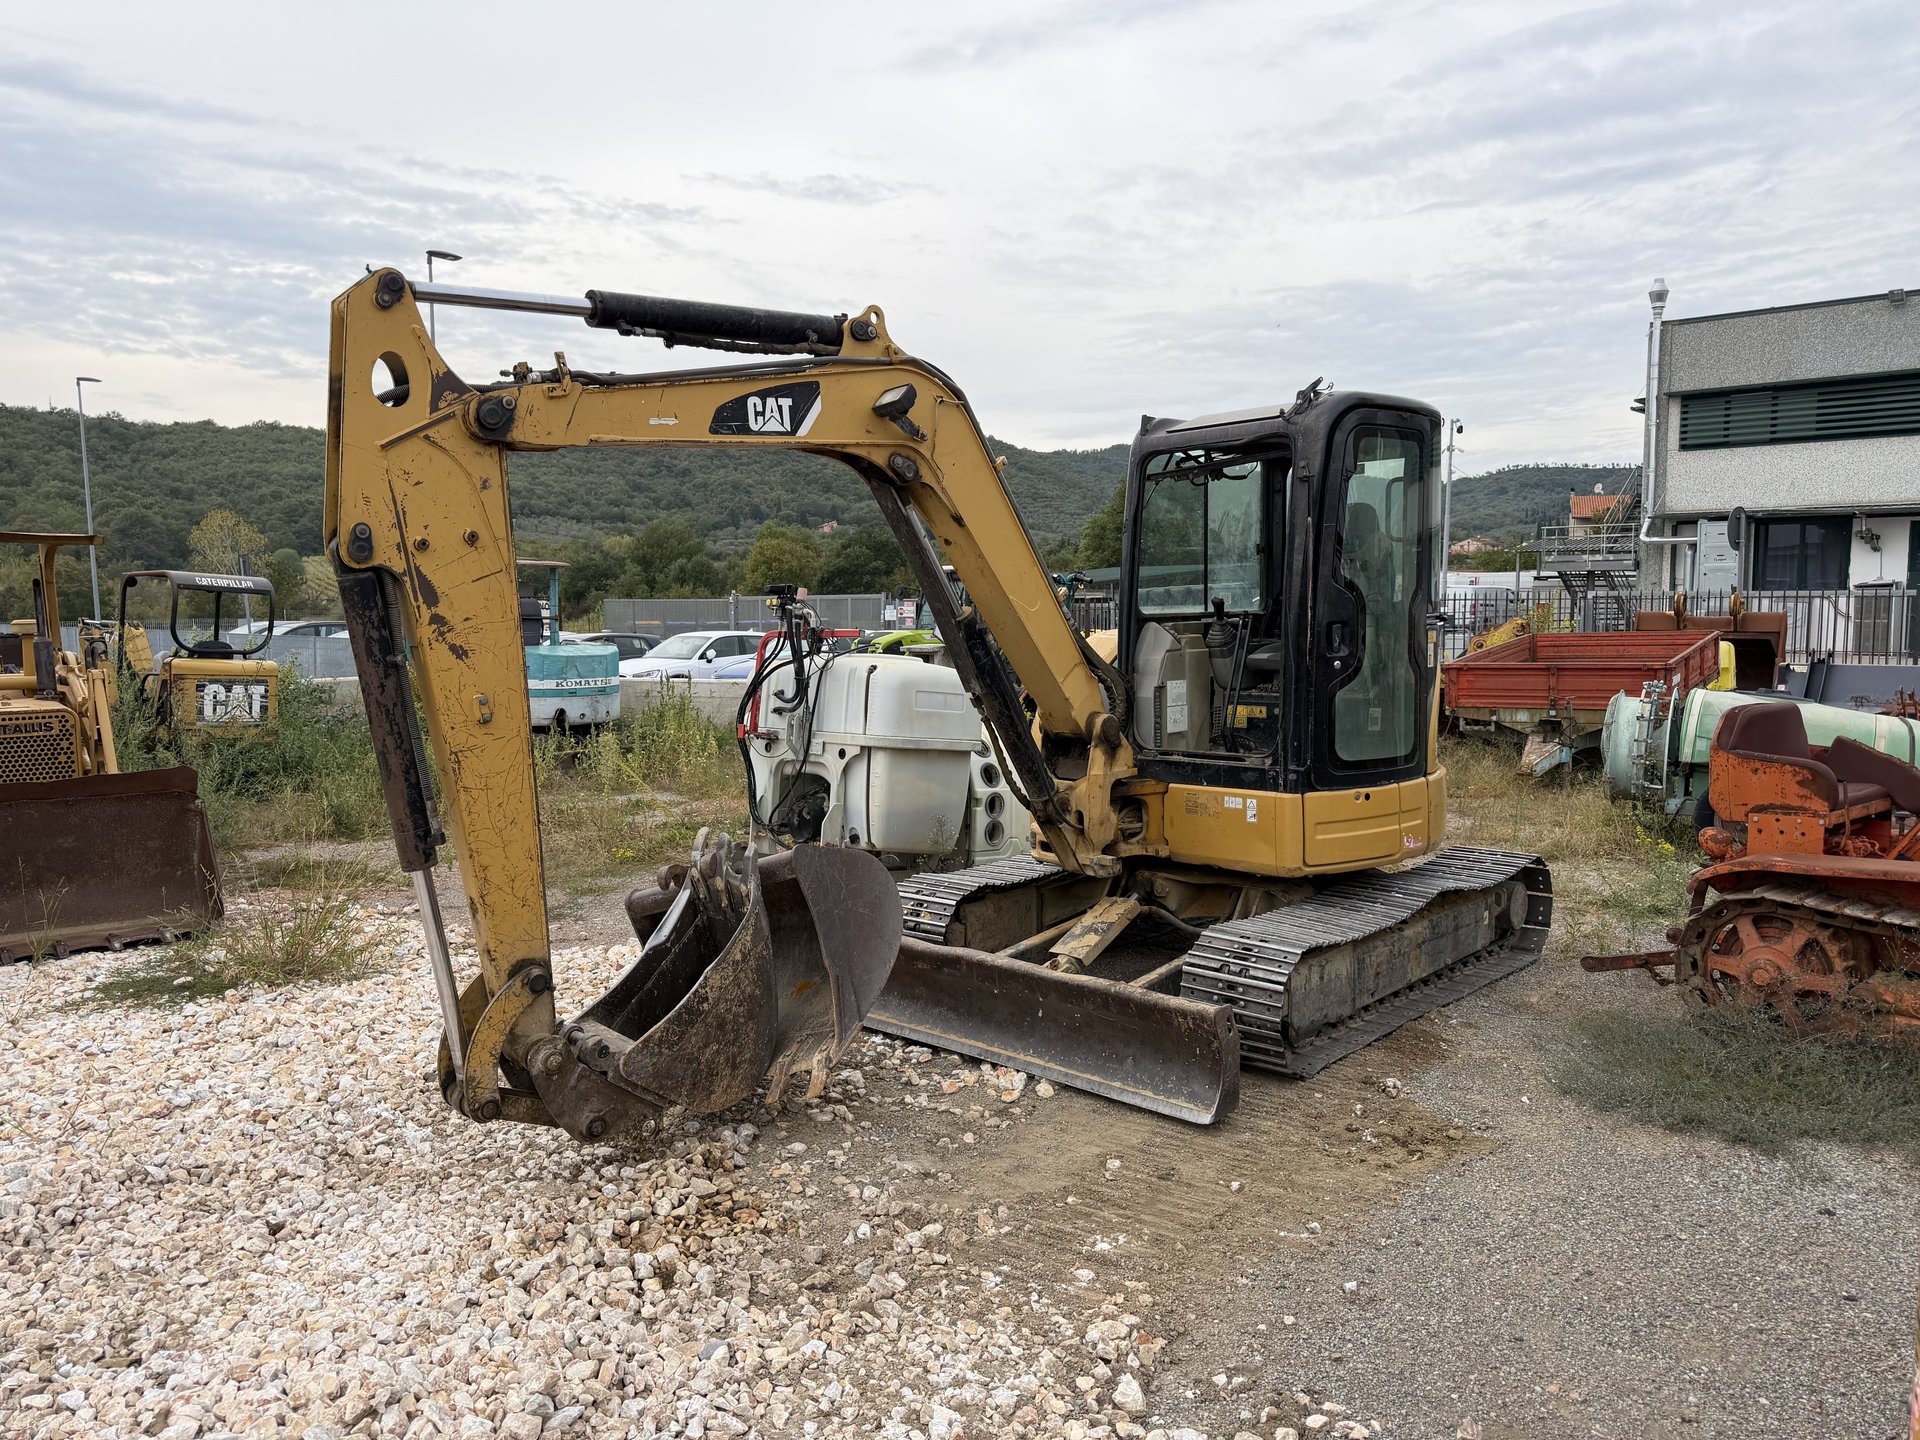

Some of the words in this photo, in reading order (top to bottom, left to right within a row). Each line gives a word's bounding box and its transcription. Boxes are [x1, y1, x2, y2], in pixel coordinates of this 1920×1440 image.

[747, 396, 792, 432] CAT
[195, 577, 254, 588] CATERPILLAR
[555, 678, 613, 688] KOMATSU
[204, 684, 265, 722] CAT
